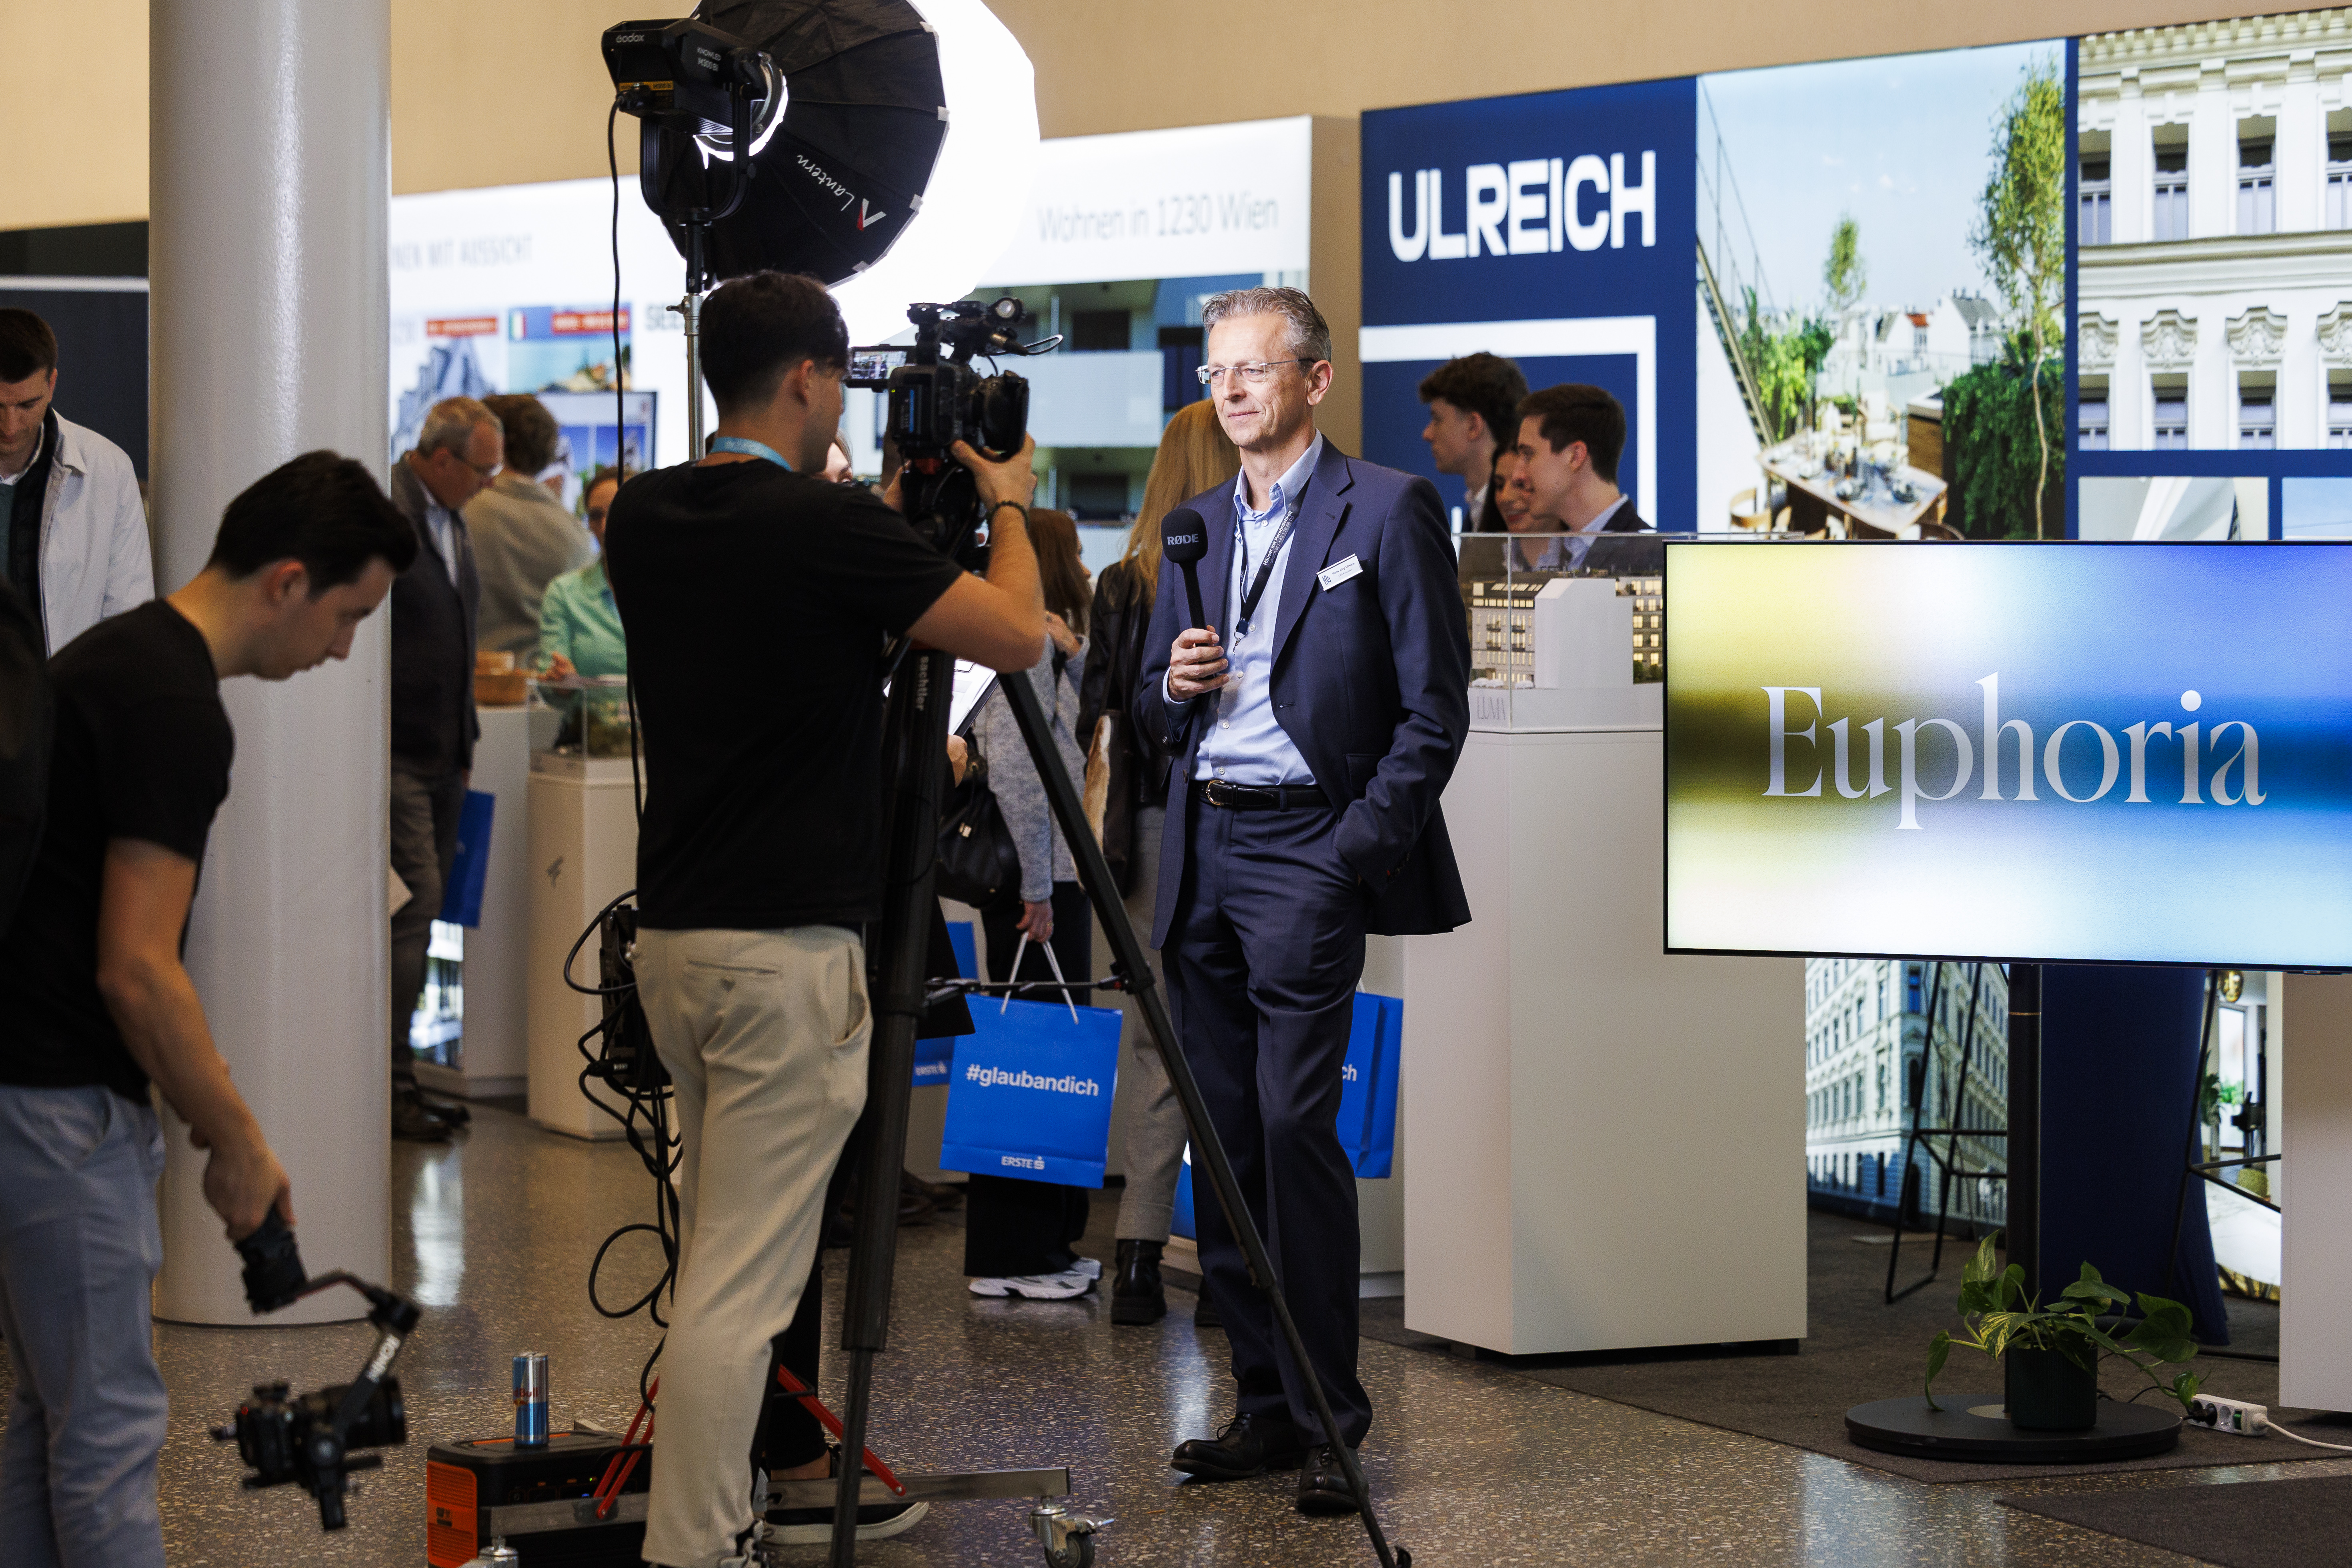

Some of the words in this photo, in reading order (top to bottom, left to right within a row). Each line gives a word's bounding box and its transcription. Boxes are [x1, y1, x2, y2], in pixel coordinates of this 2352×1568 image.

[616, 33, 645, 43] Godox
[797, 155, 855, 211] Lantern
[1037, 203, 1125, 242] Wohnen
[1133, 199, 1149, 237] in
[1158, 194, 1213, 237] 1230
[1218, 190, 1279, 231] Wien
[1388, 149, 1657, 262] ULREICH
[1167, 534, 1199, 545] RØDE
[1263, 549, 1273, 566] Häuser
[1274, 510, 1293, 541] Persönlichkeit
[1270, 545, 1279, 564] ulreich.at
[1760, 671, 2267, 830] Euphoria
[966, 1063, 1099, 1096] #glaubandich
[1001, 1155, 1033, 1168] ERSTE
